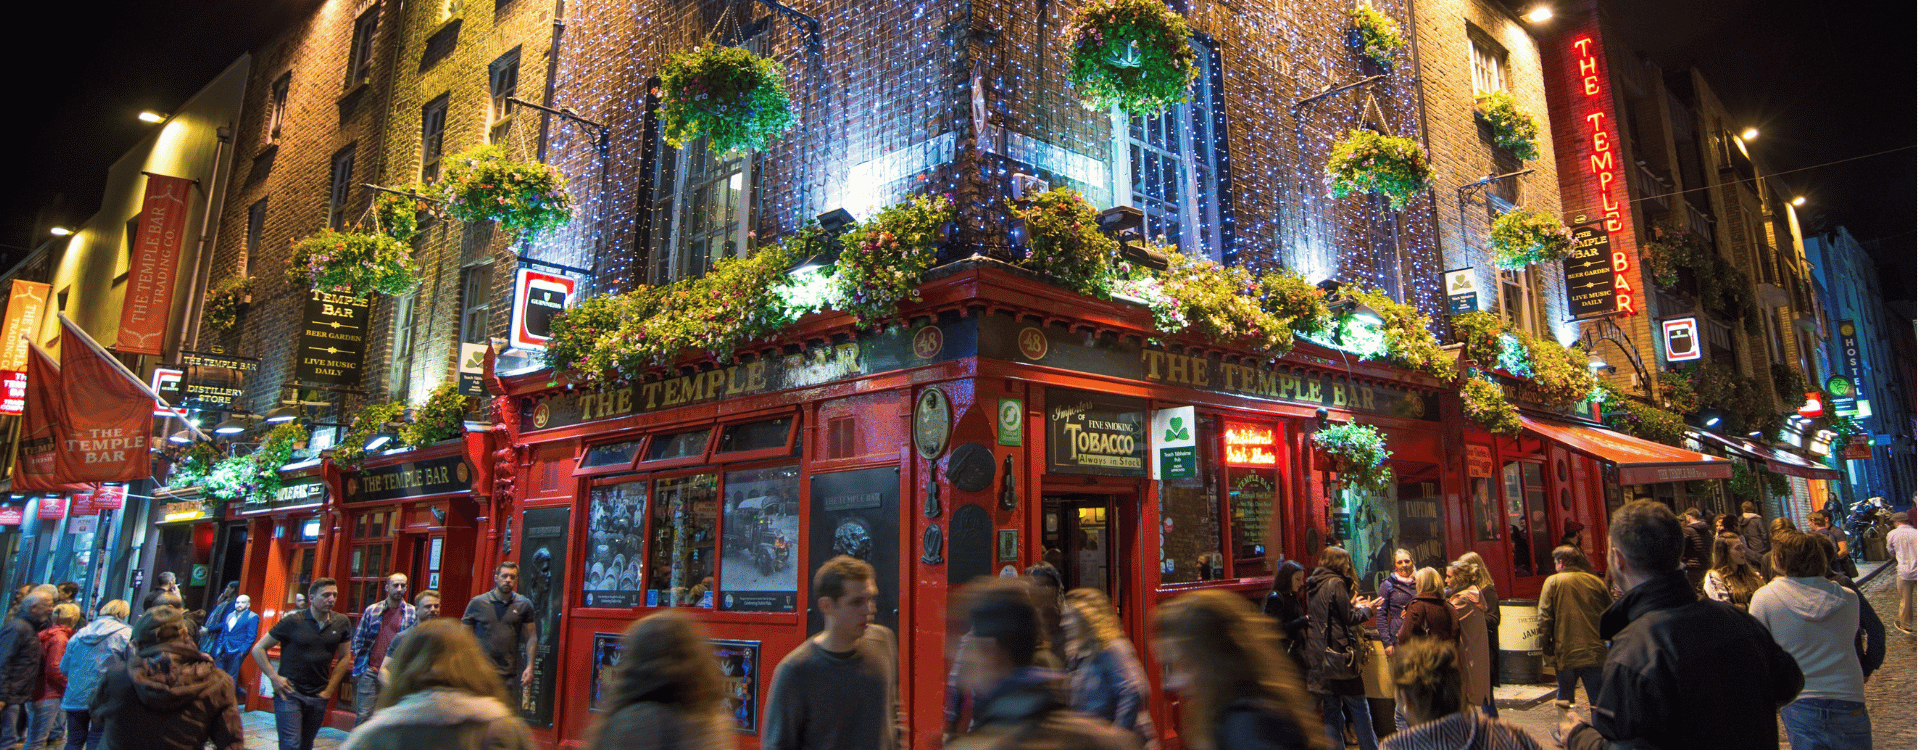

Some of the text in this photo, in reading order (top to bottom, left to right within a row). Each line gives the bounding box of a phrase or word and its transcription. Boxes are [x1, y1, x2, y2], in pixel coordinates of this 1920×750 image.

[1574, 38, 1634, 313] THE TEMPLE BAR
[1576, 230, 1592, 239] THE
[1575, 248, 1600, 259] BAR
[131, 207, 166, 323] THE TEMPLE BAR
[152, 228, 176, 305] TRADING CO.
[1567, 267, 1611, 280] BEER GARDEN
[310, 288, 369, 308] TEMPLE
[1572, 290, 1612, 301] LIVE MUSIC
[1581, 299, 1603, 307] DAILY
[321, 303, 354, 318] BAR
[305, 329, 362, 342] BEER GARDEN
[918, 332, 938, 353] 48
[1023, 331, 1042, 354] 48
[183, 356, 257, 371] THE TEMPLE BAR
[304, 357, 357, 369] LIVE MUSIC
[1845, 338, 1863, 396] HOSTEL
[315, 367, 344, 377] DAILY
[1142, 348, 1210, 387] THE
[1220, 362, 1323, 403] TEMPLE
[1332, 381, 1376, 411] BAR
[187, 384, 245, 397] DISTILLERY
[580, 387, 632, 420] THE
[642, 360, 768, 409] TEMPLE
[199, 394, 232, 404] STORE
[1052, 401, 1093, 423] Importers
[1077, 413, 1086, 421] OF
[89, 428, 123, 438] THE
[1088, 419, 1134, 433] FINE SMOKING
[65, 435, 145, 452] TEMPLE
[1063, 422, 1135, 460] TOBACCO
[85, 450, 126, 464] BAR
[1079, 453, 1141, 467] Always in Stock
[363, 465, 450, 493] THE TEMPLE BAR
